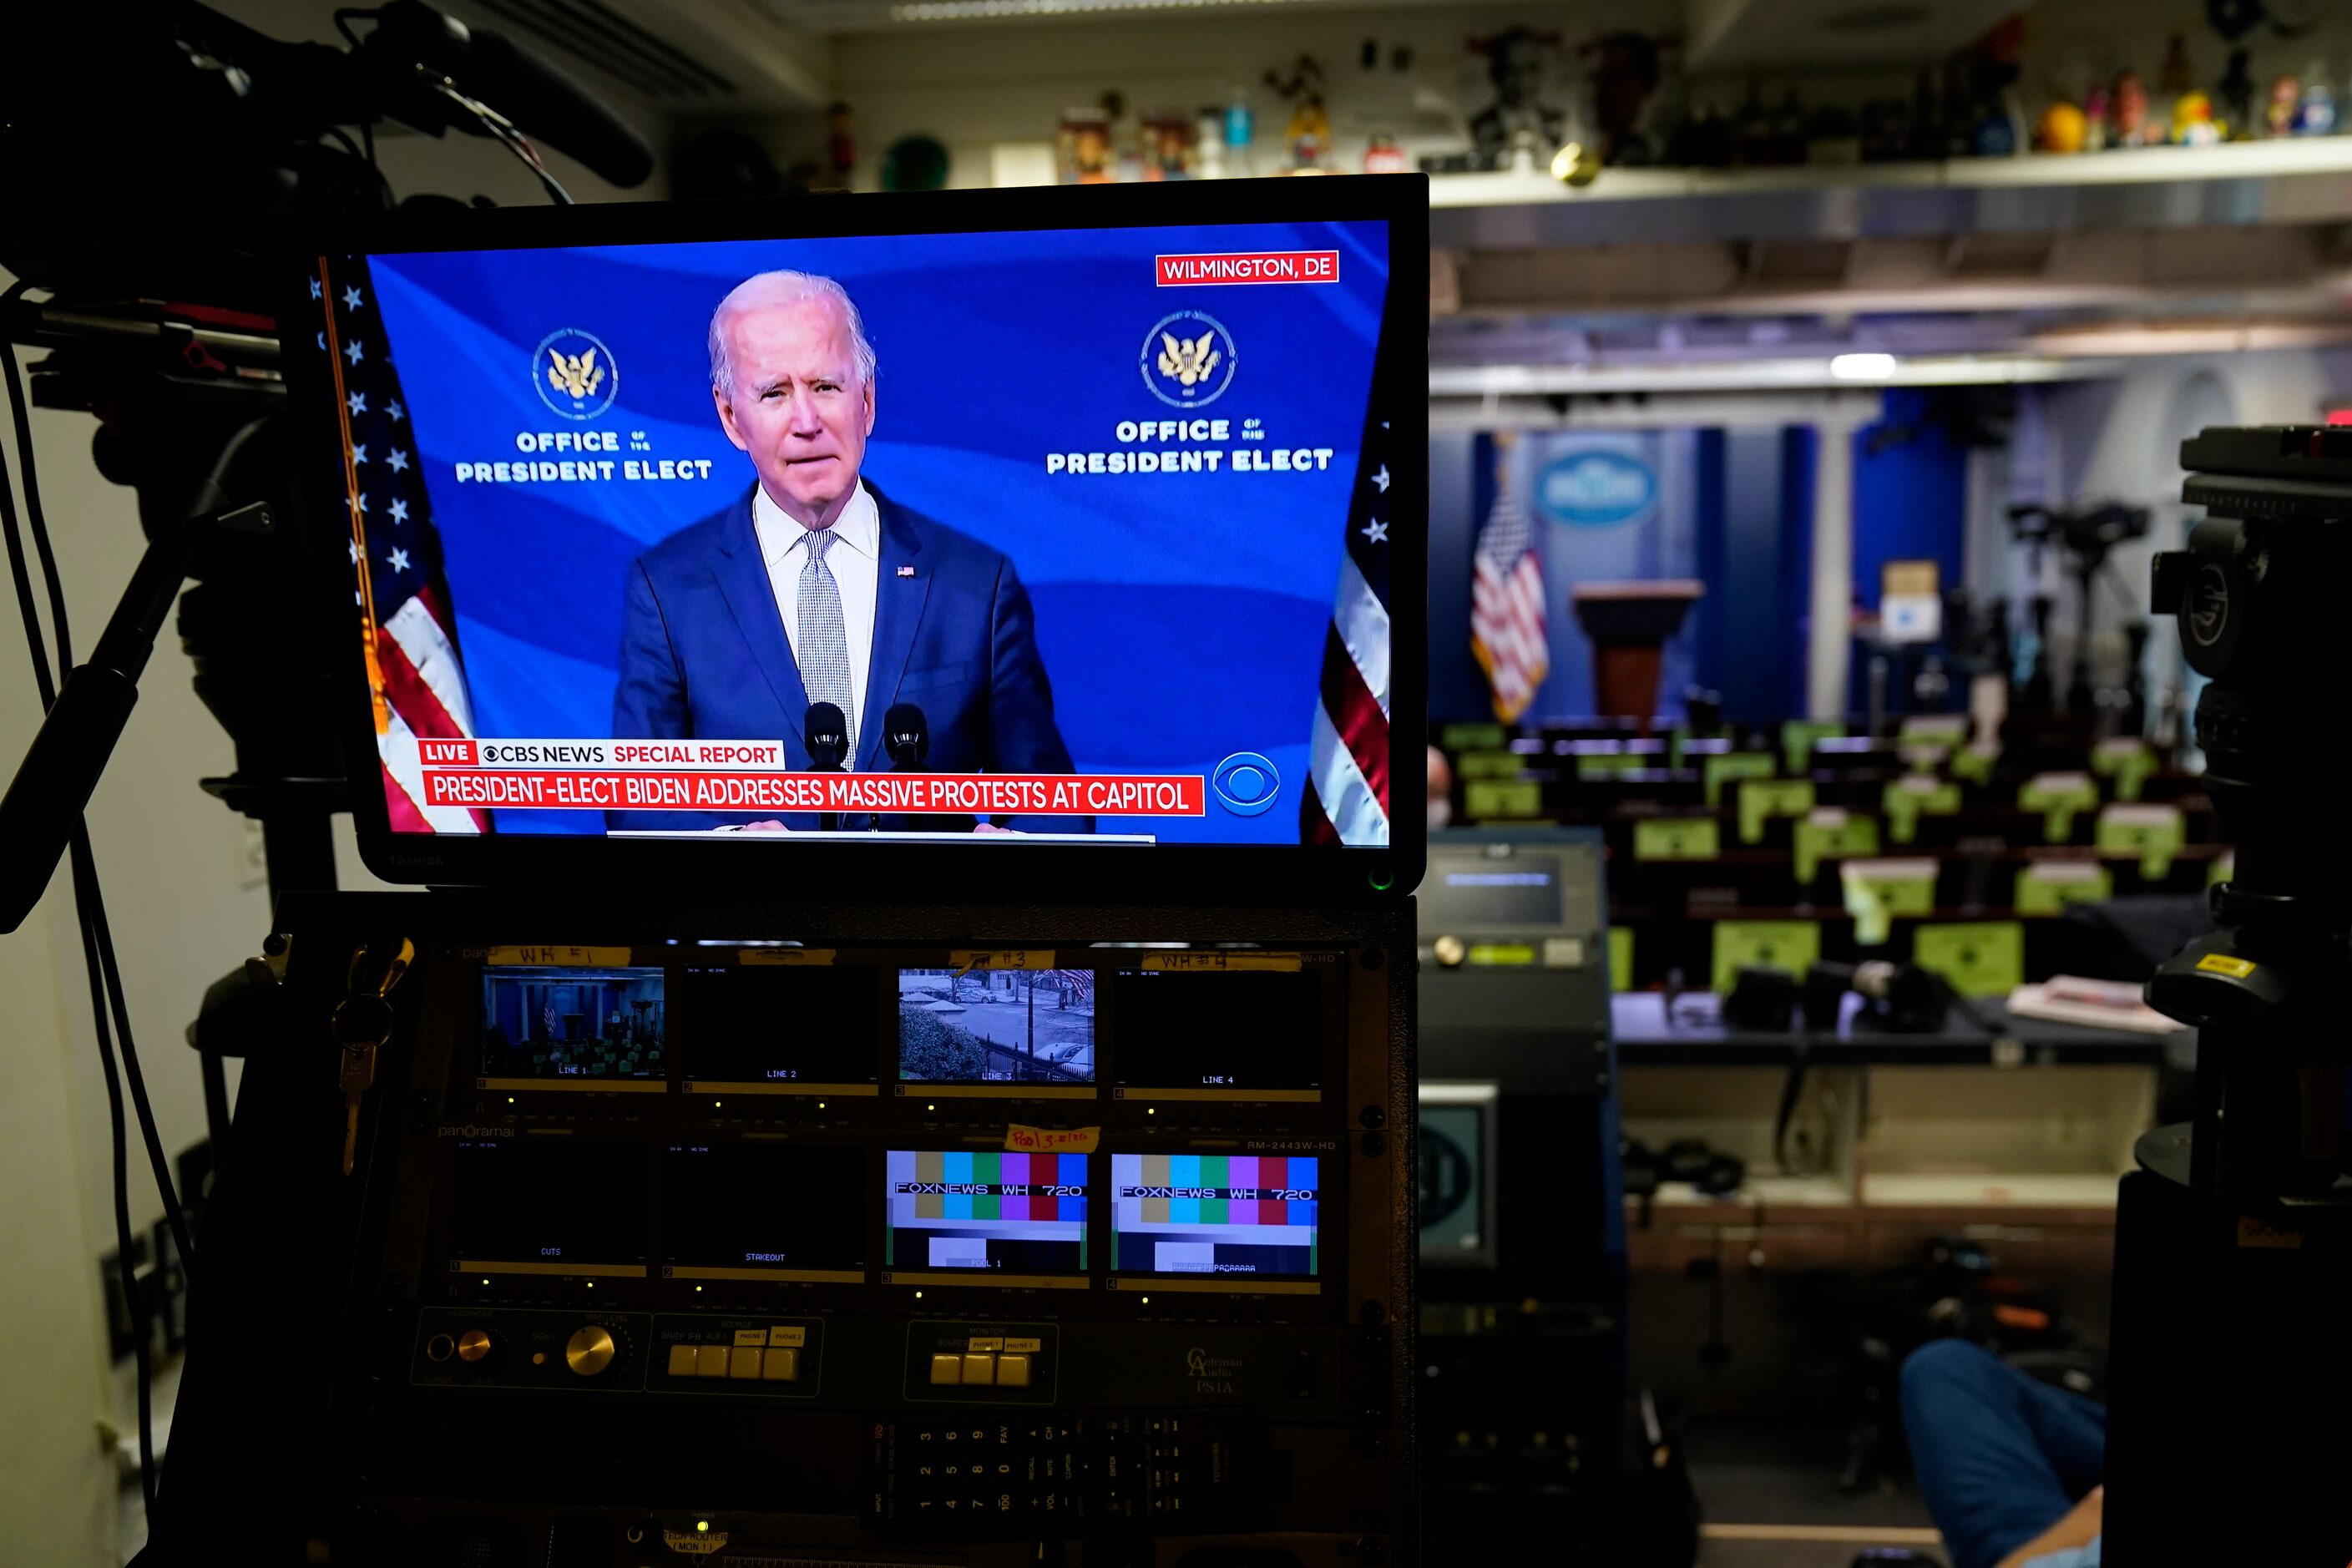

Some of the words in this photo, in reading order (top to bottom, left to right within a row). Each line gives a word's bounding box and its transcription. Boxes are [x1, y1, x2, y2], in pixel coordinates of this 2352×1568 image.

[1164, 258, 1299, 280] WILMINGTON,
[1304, 258, 1332, 276] DE
[1115, 419, 1231, 443] OFFICE
[516, 432, 620, 453] OFFICE
[1046, 450, 1223, 475] PRESIDENT
[1232, 448, 1334, 473] ELECT
[455, 460, 615, 483] PRESIDENT
[625, 459, 713, 482] ELECT
[425, 744, 469, 761] LIVE
[500, 746, 539, 763] CBS
[544, 746, 605, 764] NEWS
[615, 746, 694, 763] SPECIAL
[701, 746, 778, 764] REPORT
[433, 776, 620, 804] PRESIDENT-ELECT
[628, 777, 691, 805] BIDEN
[695, 778, 823, 807] ADDRESSES
[830, 779, 924, 807] MASSIVE
[931, 780, 1047, 809] PROTESTS
[1052, 781, 1083, 809] AT
[1087, 781, 1189, 811] CAPITOL
[559, 1066, 579, 1075] LINE
[982, 1072, 1002, 1080] LINE
[1202, 1075, 1223, 1084] LINE
[895, 1182, 989, 1195] FOXNEWS
[1002, 1185, 1029, 1196] WH
[1042, 1186, 1083, 1196] 720
[1120, 1186, 1216, 1198] FOXNEWS
[1230, 1189, 1257, 1199] WH
[1271, 1189, 1313, 1201] 720
[541, 1247, 561, 1256] CUTS
[746, 1253, 785, 1262] STAKEOUT
[448, 1309, 493, 1318] HEADPHONE
[969, 1328, 1005, 1336] MONITOR
[920, 1432, 932, 1442] 3
[946, 1431, 958, 1441] 6
[973, 1430, 984, 1440] 9
[999, 1424, 1009, 1444] FAV
[1044, 1424, 1053, 1440] CH
[920, 1464, 932, 1476] 2
[946, 1464, 958, 1475] 5
[973, 1464, 984, 1474] 8
[999, 1464, 1010, 1474] 0
[920, 1500, 932, 1509] 1
[946, 1499, 958, 1509] 4
[973, 1499, 984, 1509] 7
